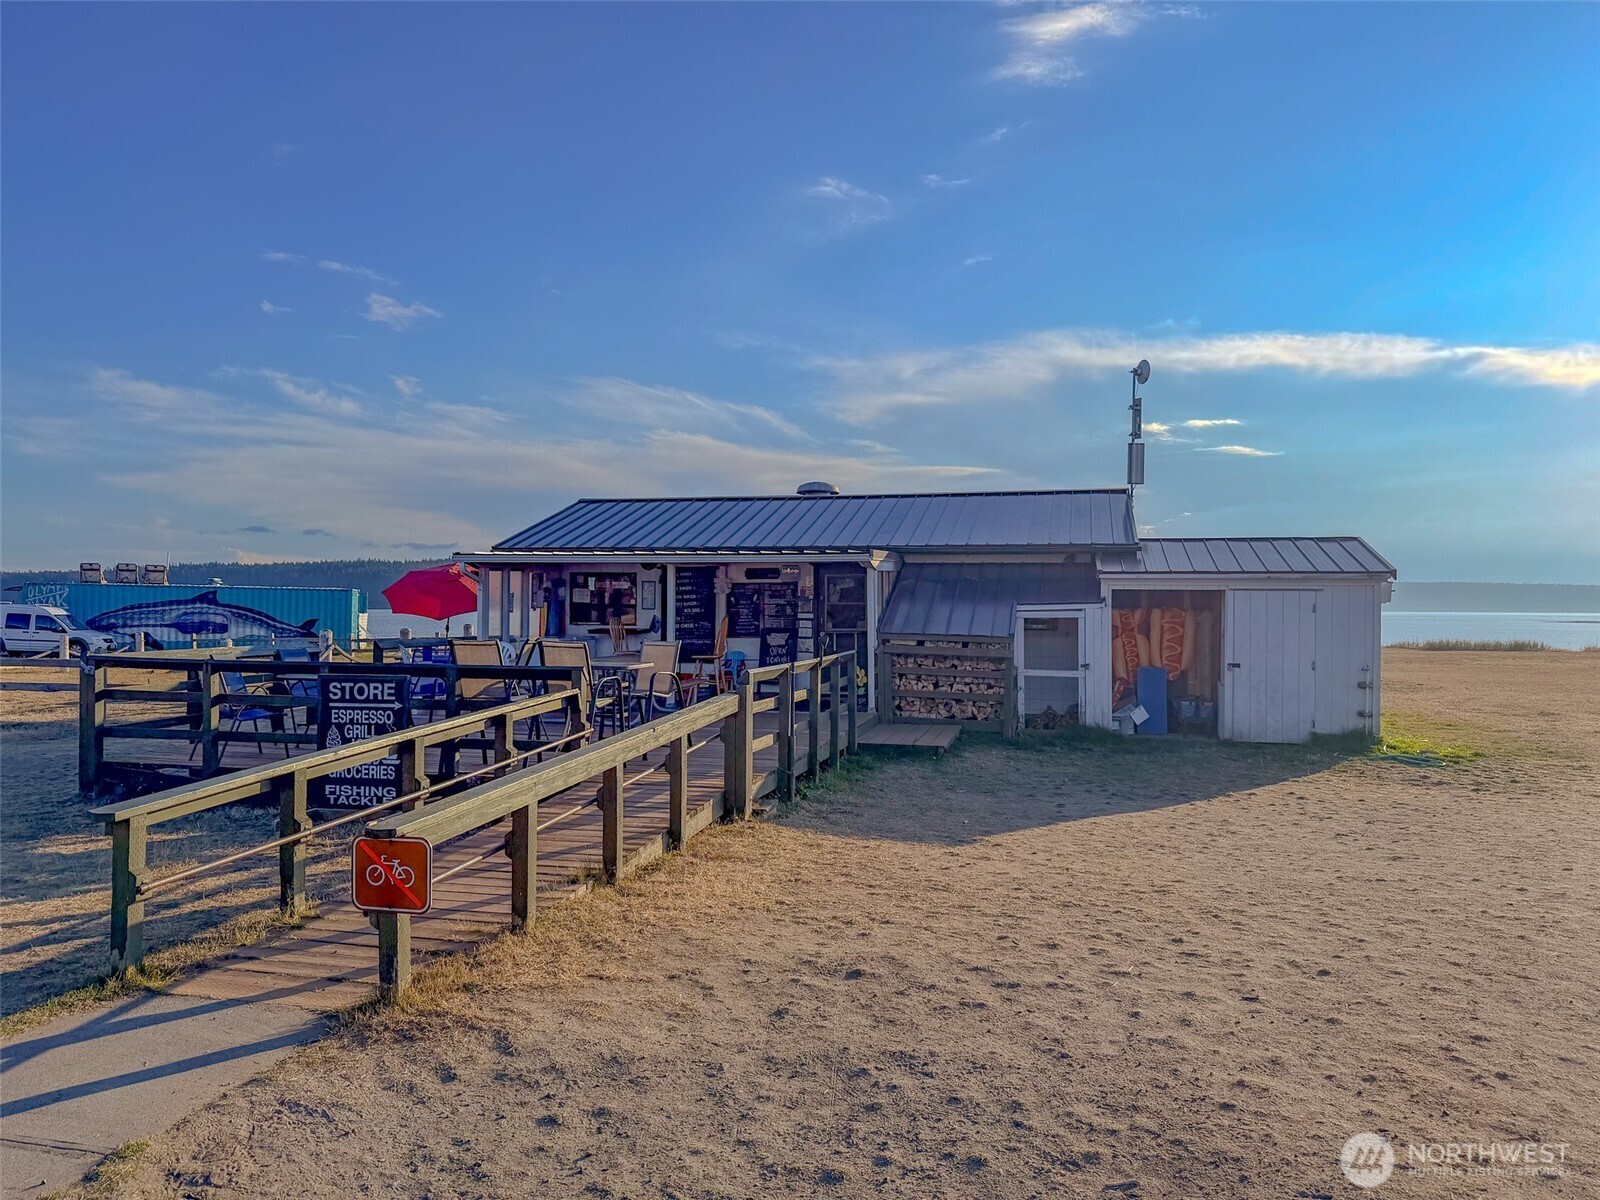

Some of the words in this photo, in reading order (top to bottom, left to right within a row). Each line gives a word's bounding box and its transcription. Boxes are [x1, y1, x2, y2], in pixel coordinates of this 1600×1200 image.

[27, 584, 69, 598] OLYMPIC
[328, 682, 396, 700] STORE
[331, 709, 394, 724] ESPRESSO
[344, 724, 376, 738] GRILL
[328, 765, 396, 780] GROCERIES
[325, 785, 397, 798] FISHING
[326, 795, 393, 807] TACKLE
